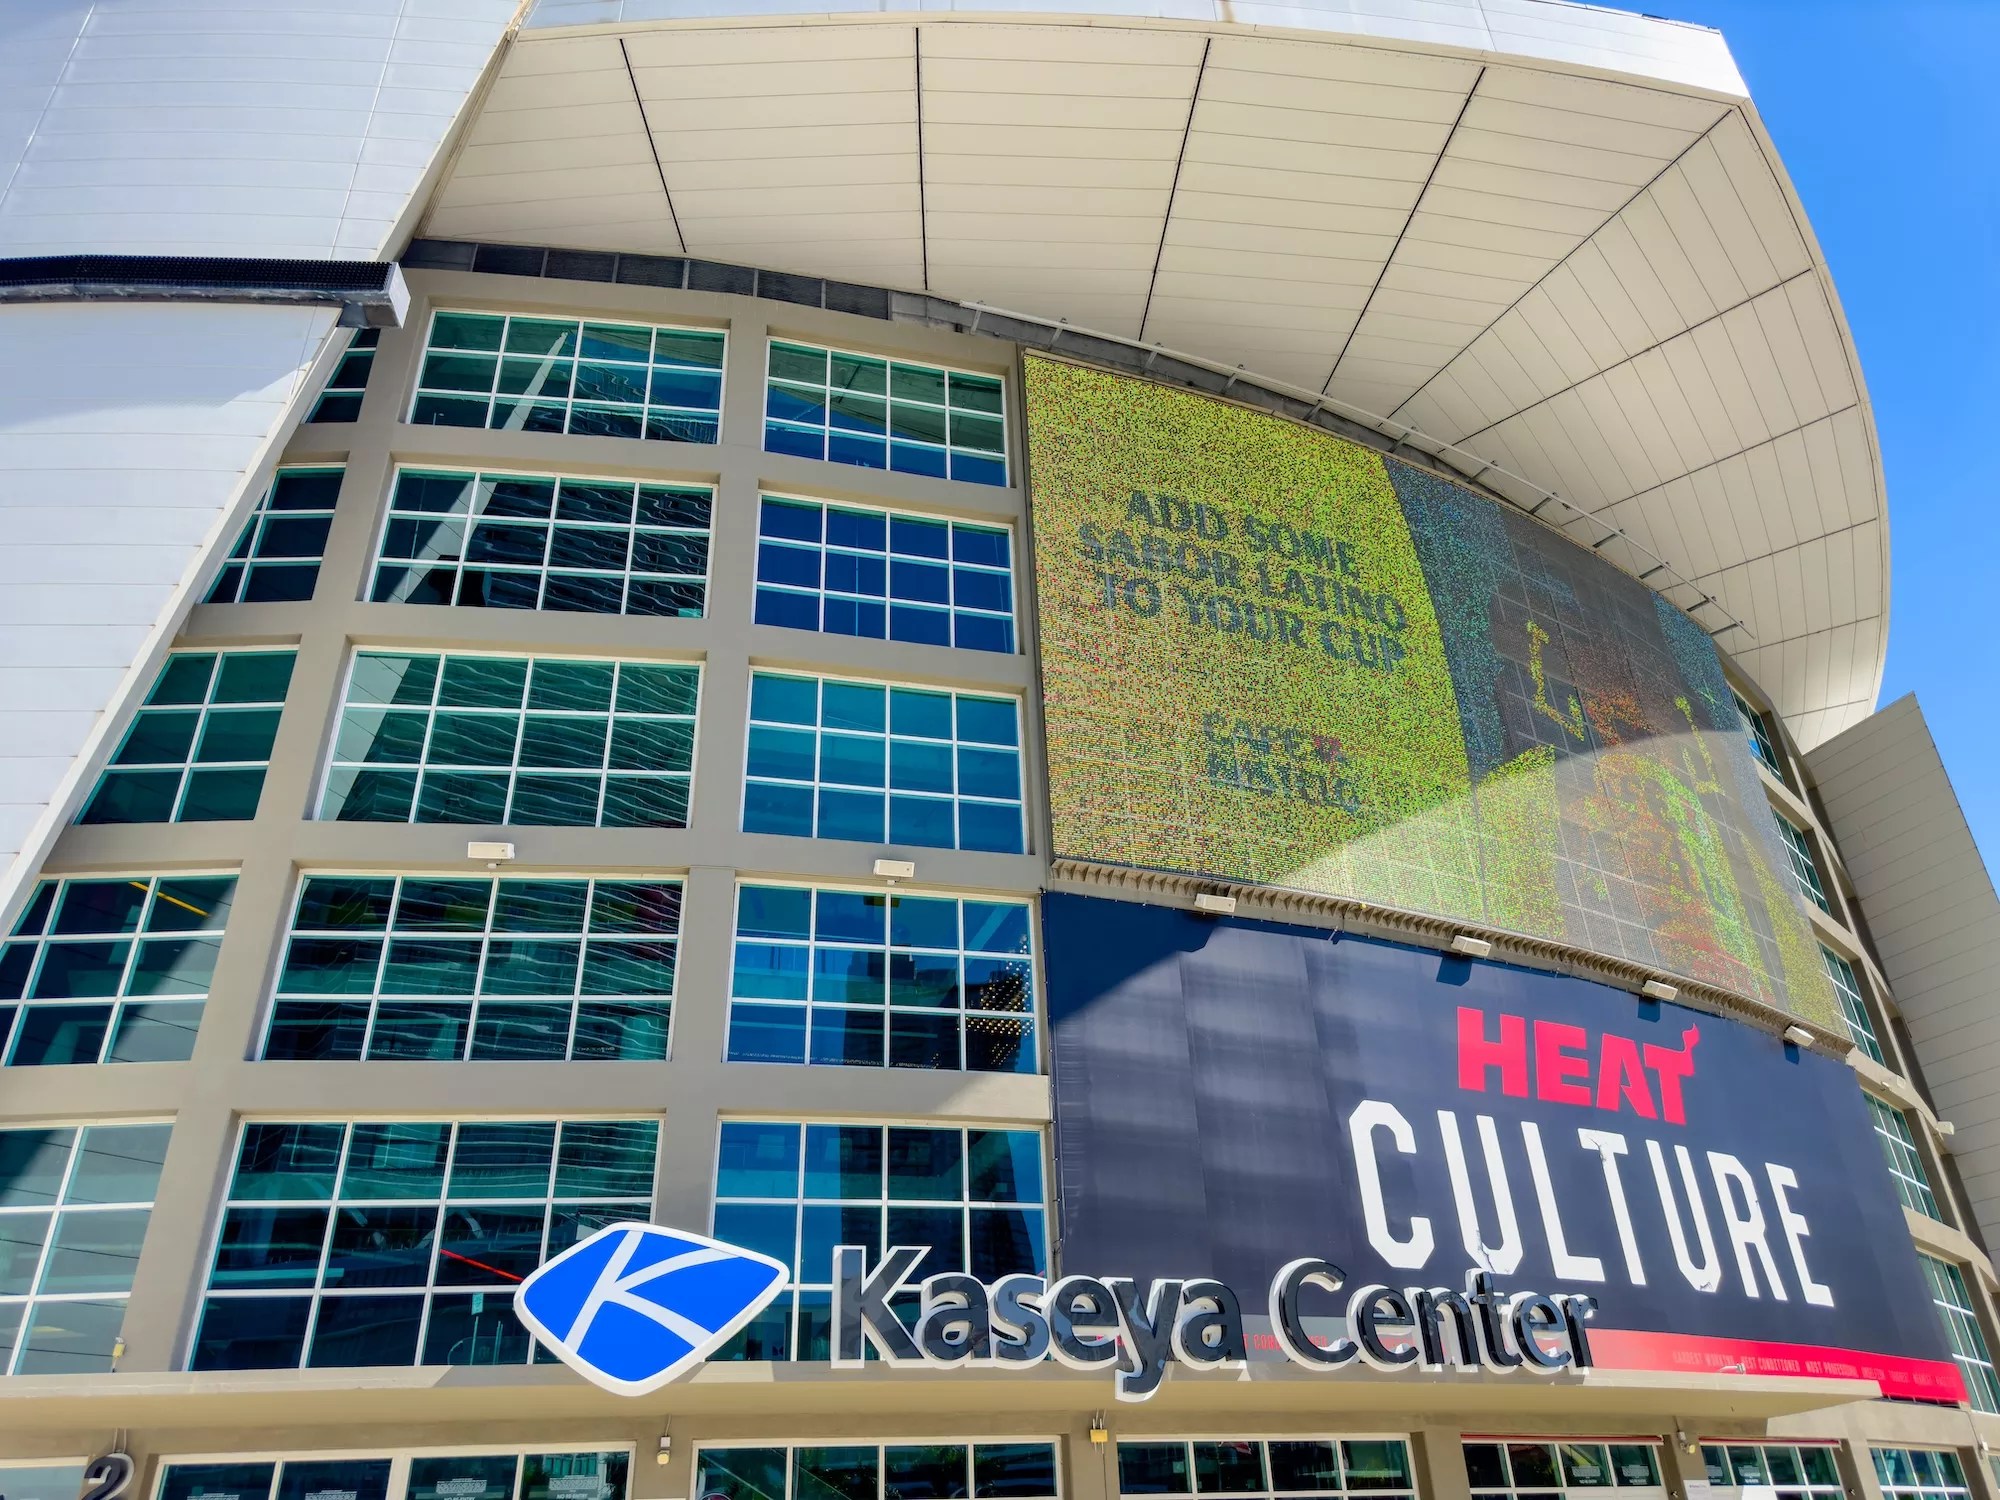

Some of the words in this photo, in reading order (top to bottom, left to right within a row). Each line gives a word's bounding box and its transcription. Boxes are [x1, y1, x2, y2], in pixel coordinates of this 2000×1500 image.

[1078, 522, 1242, 588] SABOR
[1258, 561, 1406, 632] LATINO
[1126, 490, 1228, 540] ADD
[1243, 514, 1360, 581] SOME
[1095, 571, 1162, 618] TO
[1174, 584, 1308, 648] YOUR
[1320, 621, 1406, 673] CUP
[1456, 1006, 1700, 1126] HEAT
[1349, 1100, 1835, 1307] CULTURE
[831, 1245, 1247, 1402] Kaseya
[1268, 1257, 1598, 1376] Center
